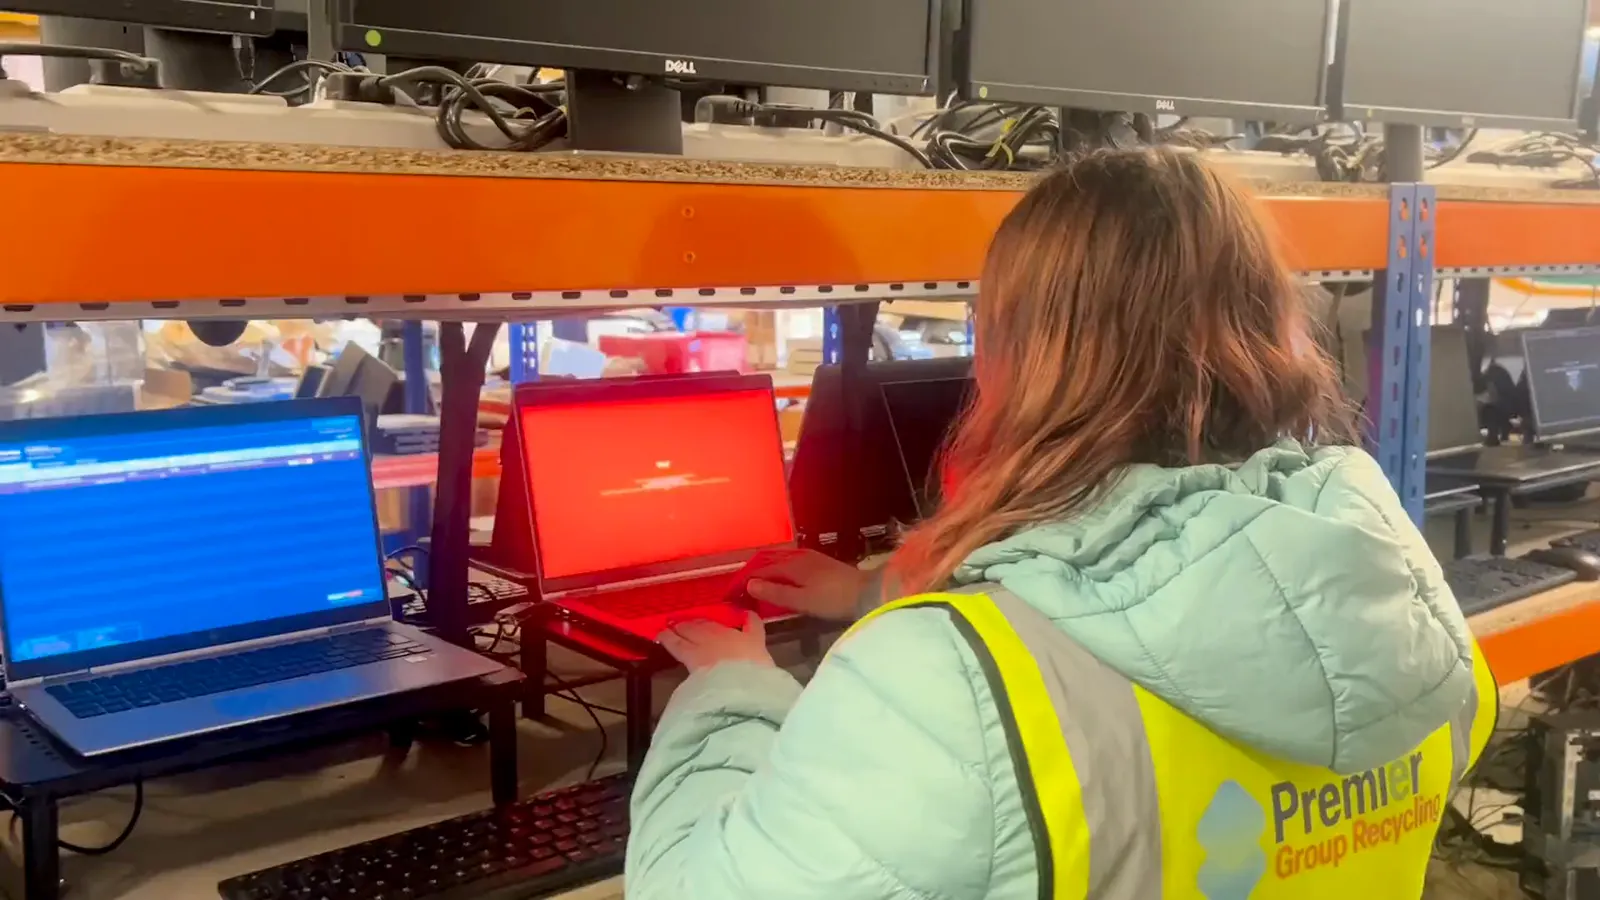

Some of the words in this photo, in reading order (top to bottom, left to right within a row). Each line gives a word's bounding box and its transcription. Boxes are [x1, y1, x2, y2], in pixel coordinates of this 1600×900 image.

[665, 60, 697, 74] DELL
[1271, 751, 1423, 844] Premier
[1275, 833, 1348, 880] Group
[1353, 793, 1441, 853] Recycling
